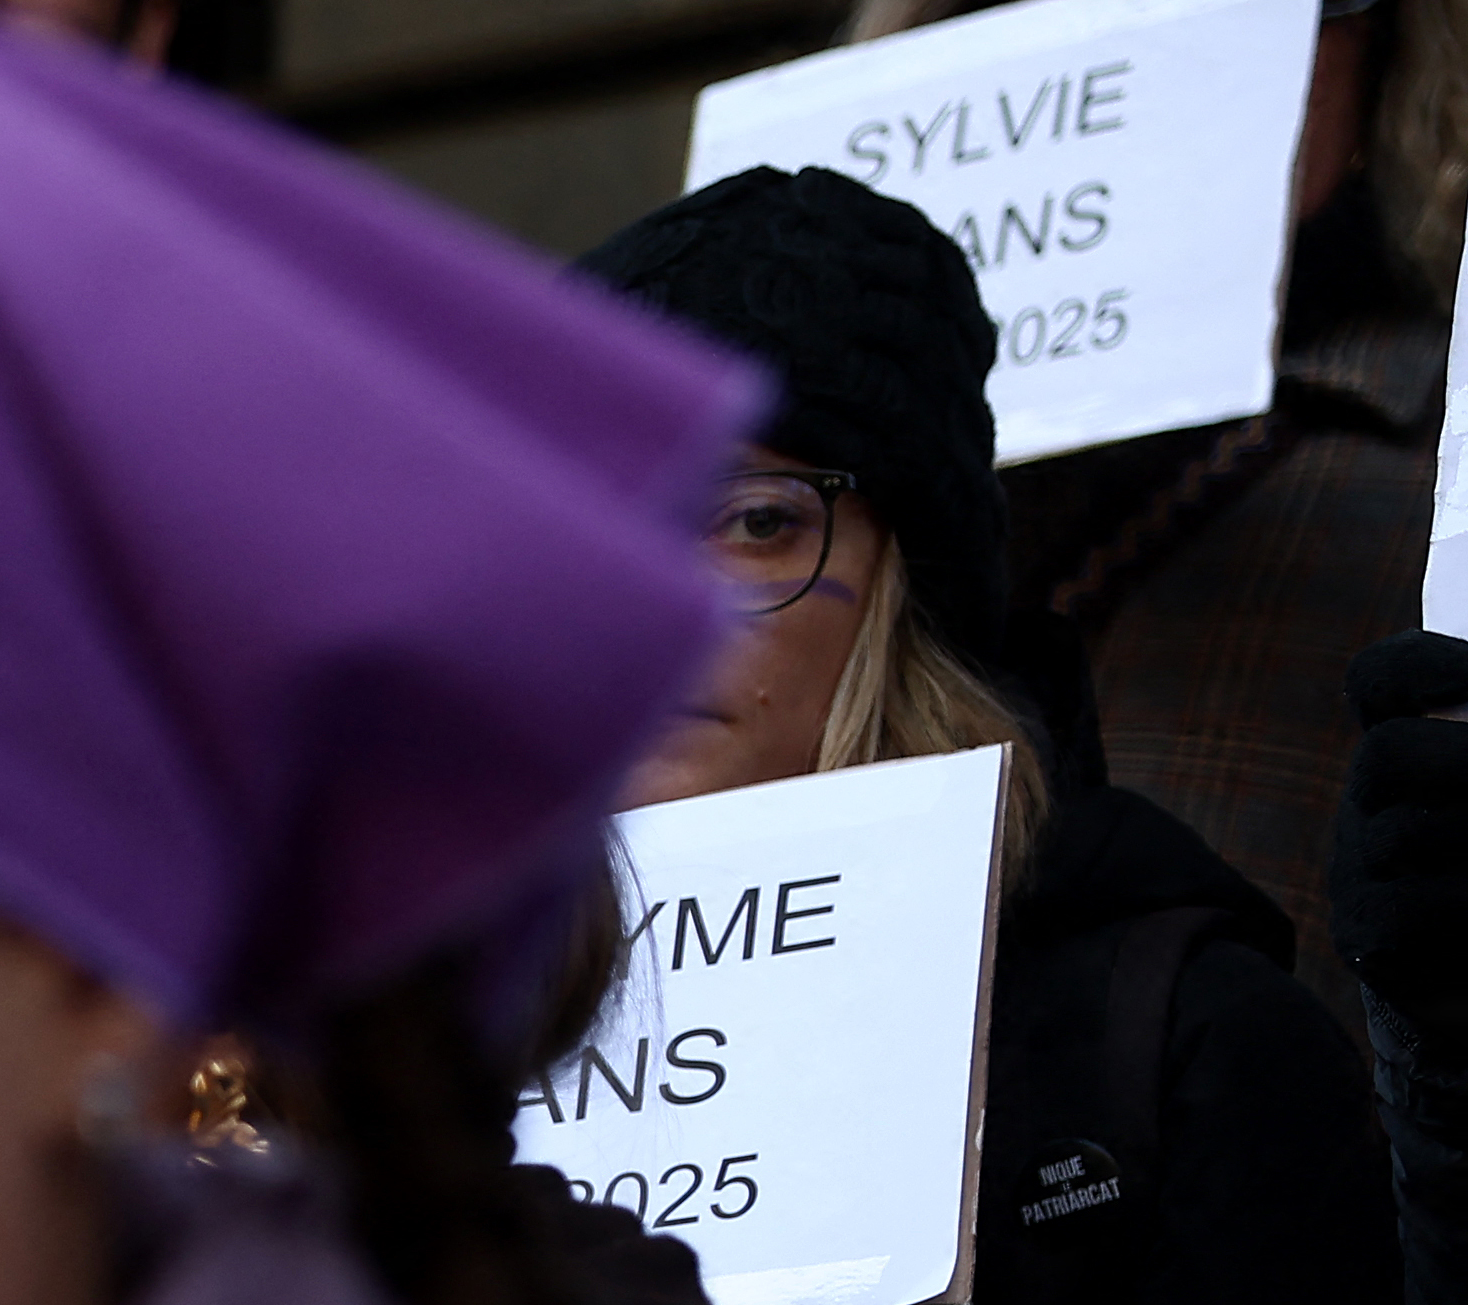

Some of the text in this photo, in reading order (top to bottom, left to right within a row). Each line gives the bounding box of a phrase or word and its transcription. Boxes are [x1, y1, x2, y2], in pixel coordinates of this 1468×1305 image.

[846, 58, 1135, 186] SYLVIE
[953, 180, 1112, 270] ANS
[996, 288, 1131, 368] 025
[1021, 1176, 1120, 1226] PATRIARCAT
[1039, 1154, 1086, 1188] NIQUE
